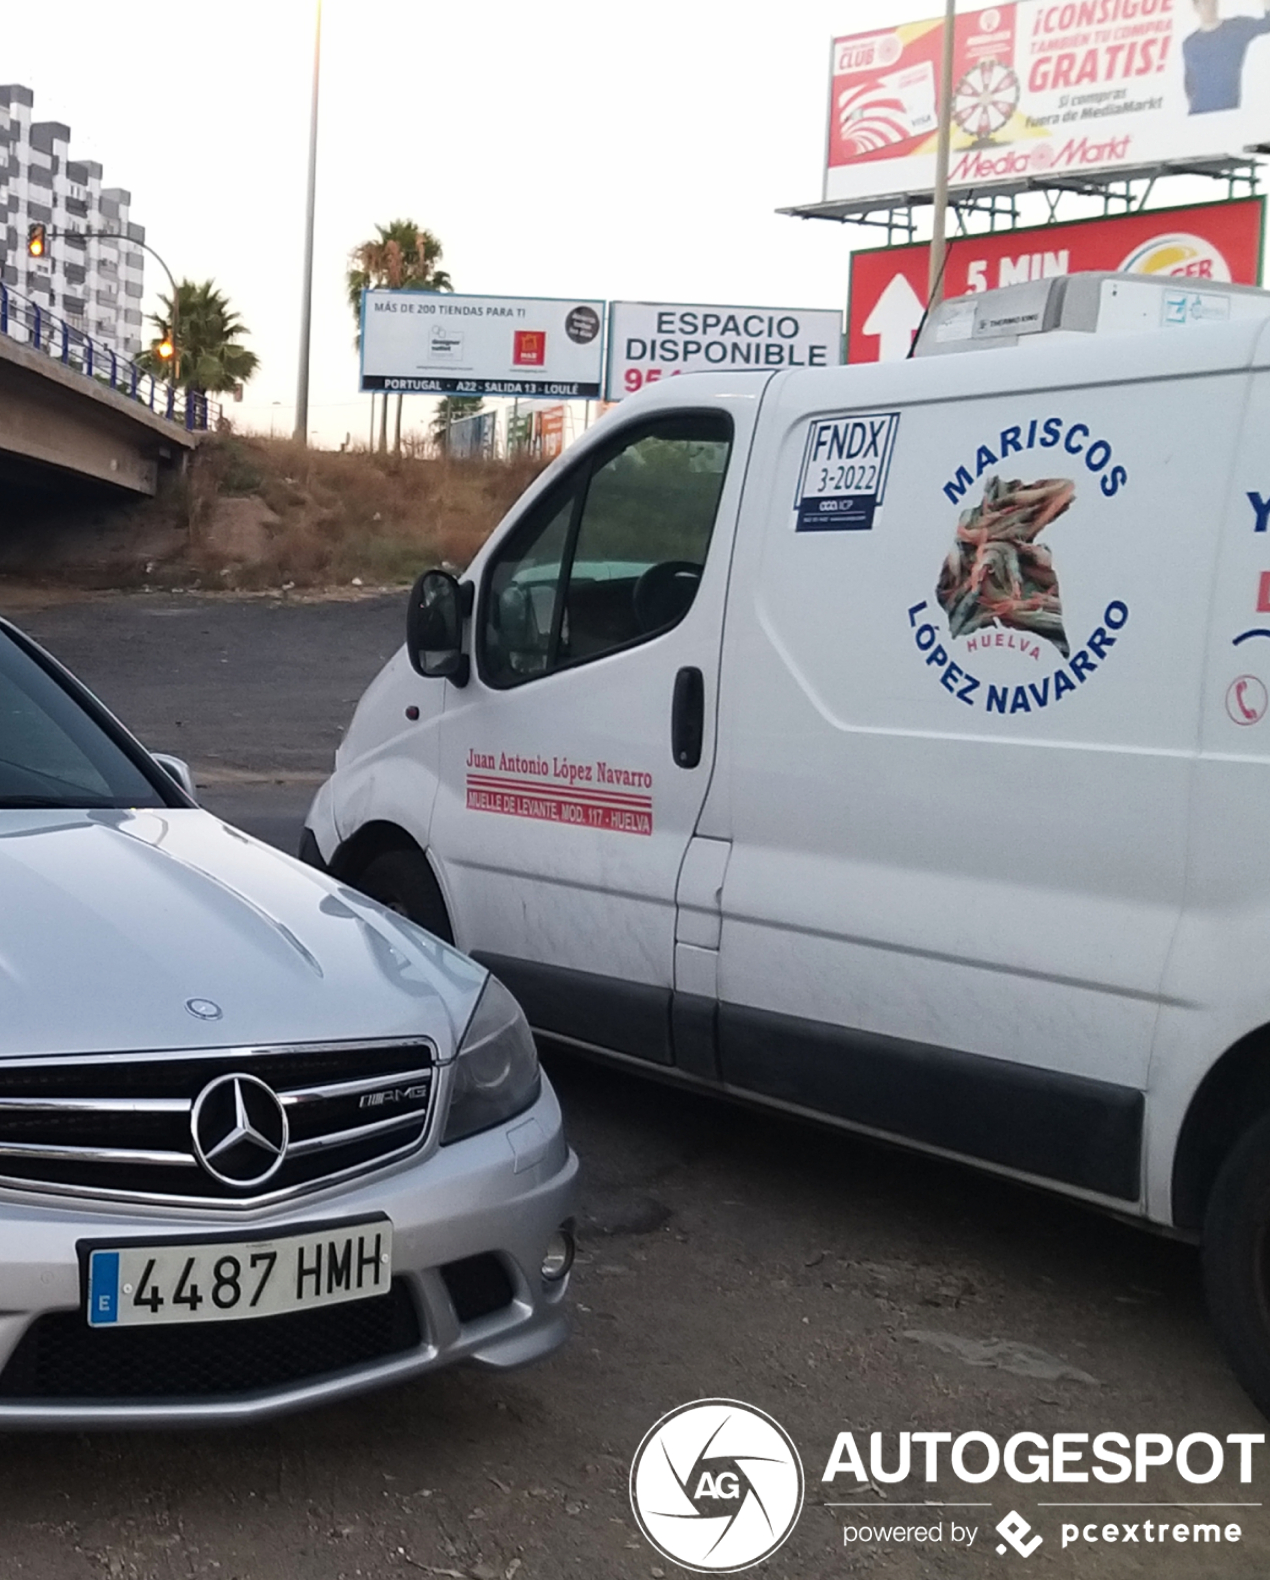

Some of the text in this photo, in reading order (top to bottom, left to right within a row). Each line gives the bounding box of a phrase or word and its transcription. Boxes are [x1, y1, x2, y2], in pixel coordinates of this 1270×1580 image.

[839, 47, 875, 70] CLUB
[1028, 36, 1171, 93] GRATIS!
[1062, 110, 1078, 123] de
[1080, 97, 1163, 119] MediaMarkt
[946, 134, 1131, 180] Media Markt
[965, 250, 1070, 295] 5 MIN
[374, 301, 526, 318] MÁS DE 200 TIENDAS PARA TI
[656, 311, 800, 339] ESPACIO
[625, 338, 828, 366] DISPONIBLE
[384, 379, 442, 391] PORTUGAL
[456, 381, 477, 391] A22
[484, 382, 522, 393] SALIDA
[524, 383, 536, 394] 13
[544, 383, 579, 395] LOULÉ
[812, 420, 886, 461] FNDX
[942, 417, 1127, 505] MARISCOS
[817, 465, 877, 492] 3-2022
[908, 600, 1129, 714] LÓPEZ NAVARRO
[967, 633, 1041, 661] HUELVA
[466, 748, 652, 789] Juan Antonio López Navarro
[468, 791, 502, 812] MUELLE
[503, 795, 516, 813] DE
[588, 809, 603, 826] 117
[610, 812, 650, 833] HUELVA
[133, 1234, 382, 1313] 4487 HMH
[99, 1295, 110, 1311] E
